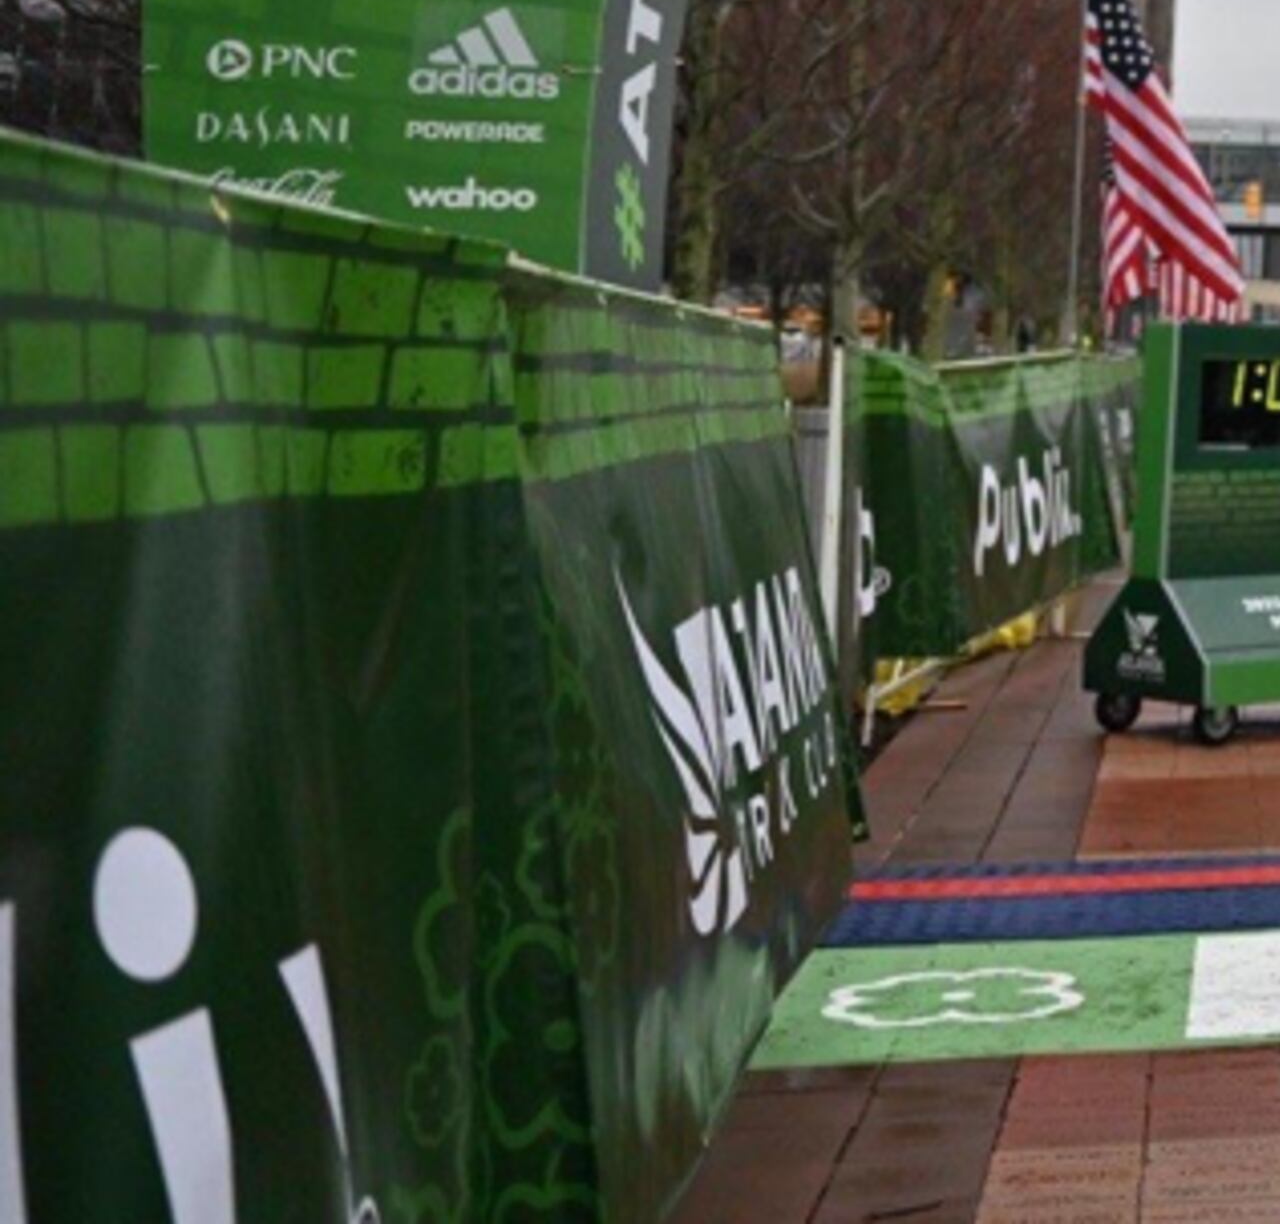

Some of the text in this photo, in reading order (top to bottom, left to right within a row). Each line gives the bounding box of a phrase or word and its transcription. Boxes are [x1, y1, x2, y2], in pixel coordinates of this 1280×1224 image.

[261, 44, 358, 78] PNC
[408, 65, 559, 99] adidas
[196, 107, 350, 147] DASANI
[405, 120, 546, 143] POWERADE
[405, 176, 537, 210] wahoo
